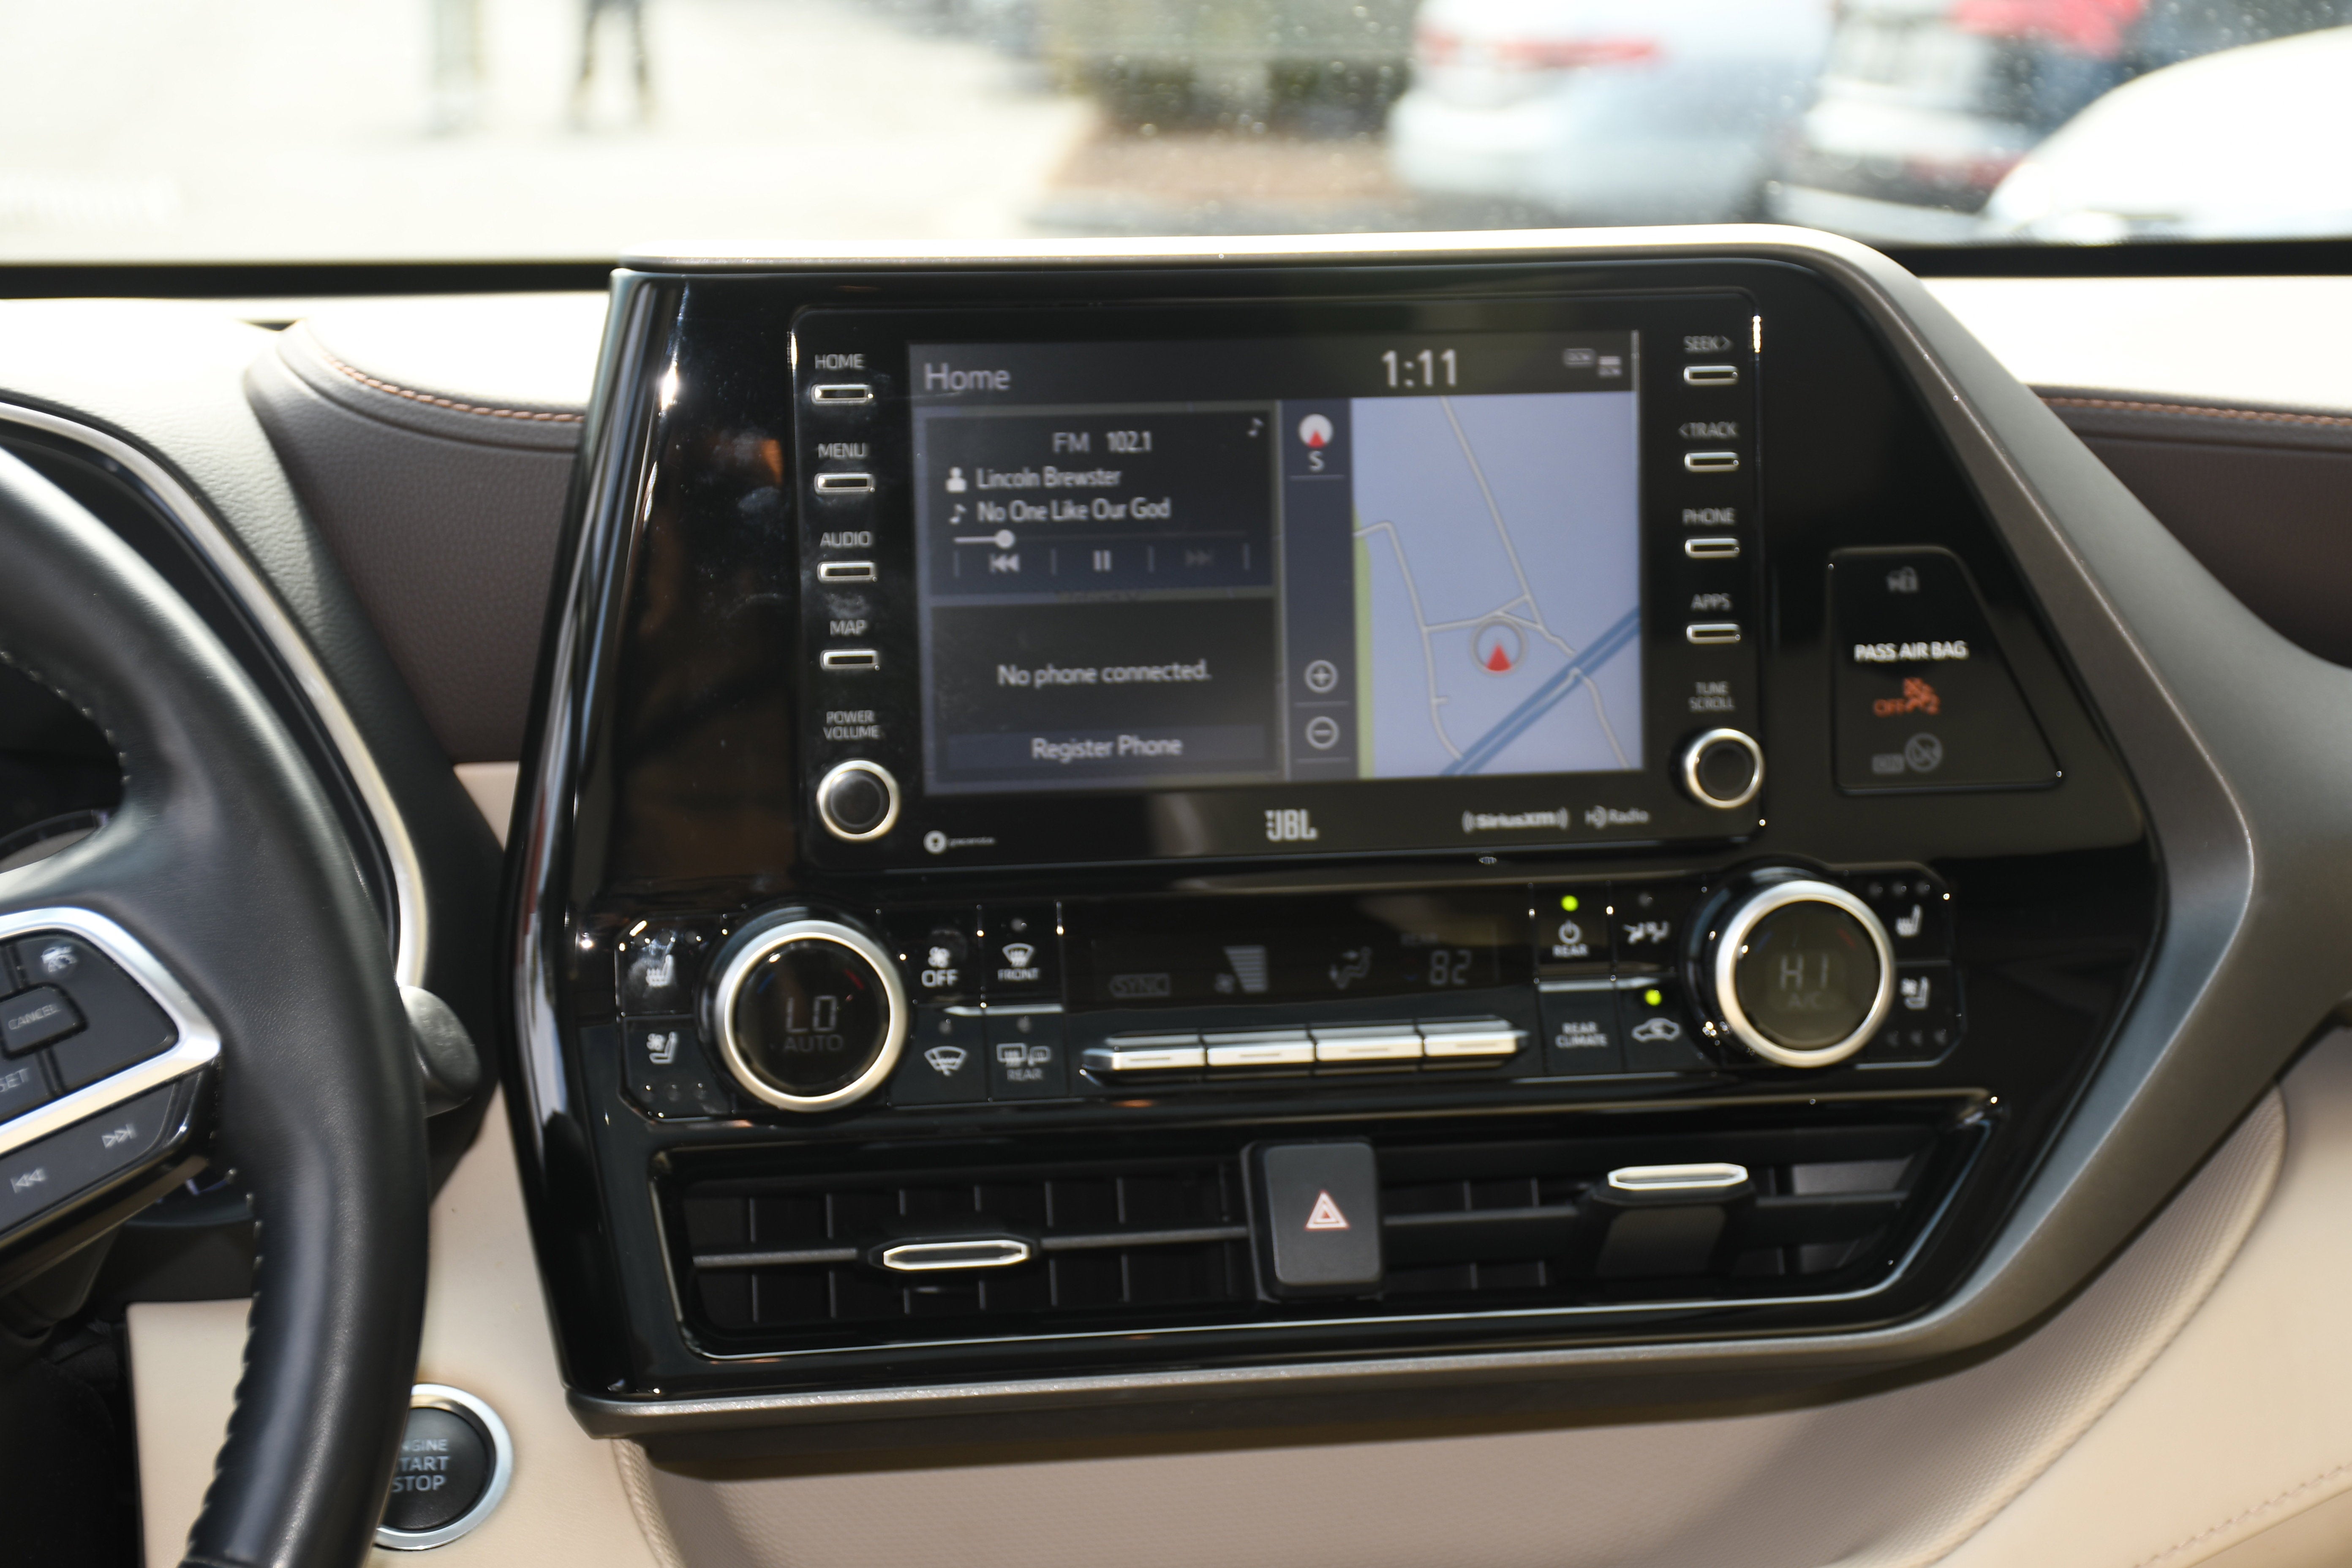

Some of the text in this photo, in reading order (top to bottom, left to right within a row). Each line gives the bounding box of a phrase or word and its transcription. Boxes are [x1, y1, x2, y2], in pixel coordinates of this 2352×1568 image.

[1684, 336, 1720, 352] SEEK
[815, 354, 864, 370] HOME
[1381, 349, 1457, 389] 1:11
[925, 363, 1010, 392] Home
[1690, 422, 1738, 438] TRACK
[1053, 431, 1152, 453] FM 102.1
[818, 443, 867, 460] MENU
[1309, 451, 1325, 472] S
[977, 466, 1121, 490] Lincoln Brewster
[978, 498, 1171, 523] No One Like Our God
[1683, 508, 1736, 525] PHONE
[820, 531, 872, 548] AUDIO
[1691, 594, 1731, 610] APPS
[830, 619, 867, 636] MAP
[1854, 640, 1969, 662] PASS AIR BAG
[997, 664, 1029, 686] No
[1035, 662, 1097, 689] phone
[1695, 682, 1728, 696] TUNE
[1689, 695, 1736, 710] SCROLL
[826, 710, 875, 725] POWER
[823, 724, 880, 740] VOLUME
[1032, 735, 1182, 764] Register Phone
[1609, 807, 1650, 824] Radio
[1266, 809, 1318, 841] JBL
[1553, 944, 1588, 958] REAR
[998, 967, 1039, 982] FRONT
[1429, 950, 1471, 985] 82
[922, 969, 957, 988] OFF
[1115, 976, 1167, 995] SYNC
[8, 1004, 61, 1030] CANCEL
[785, 995, 837, 1032] LO
[1563, 1022, 1597, 1035] REAR
[784, 1034, 843, 1054] AUTO
[1556, 1034, 1607, 1048] CLIMATE
[1007, 1068, 1043, 1081] REAR
[402, 1438, 449, 1452] GINE
[396, 1455, 449, 1472] TART
[391, 1474, 446, 1492] STOP
